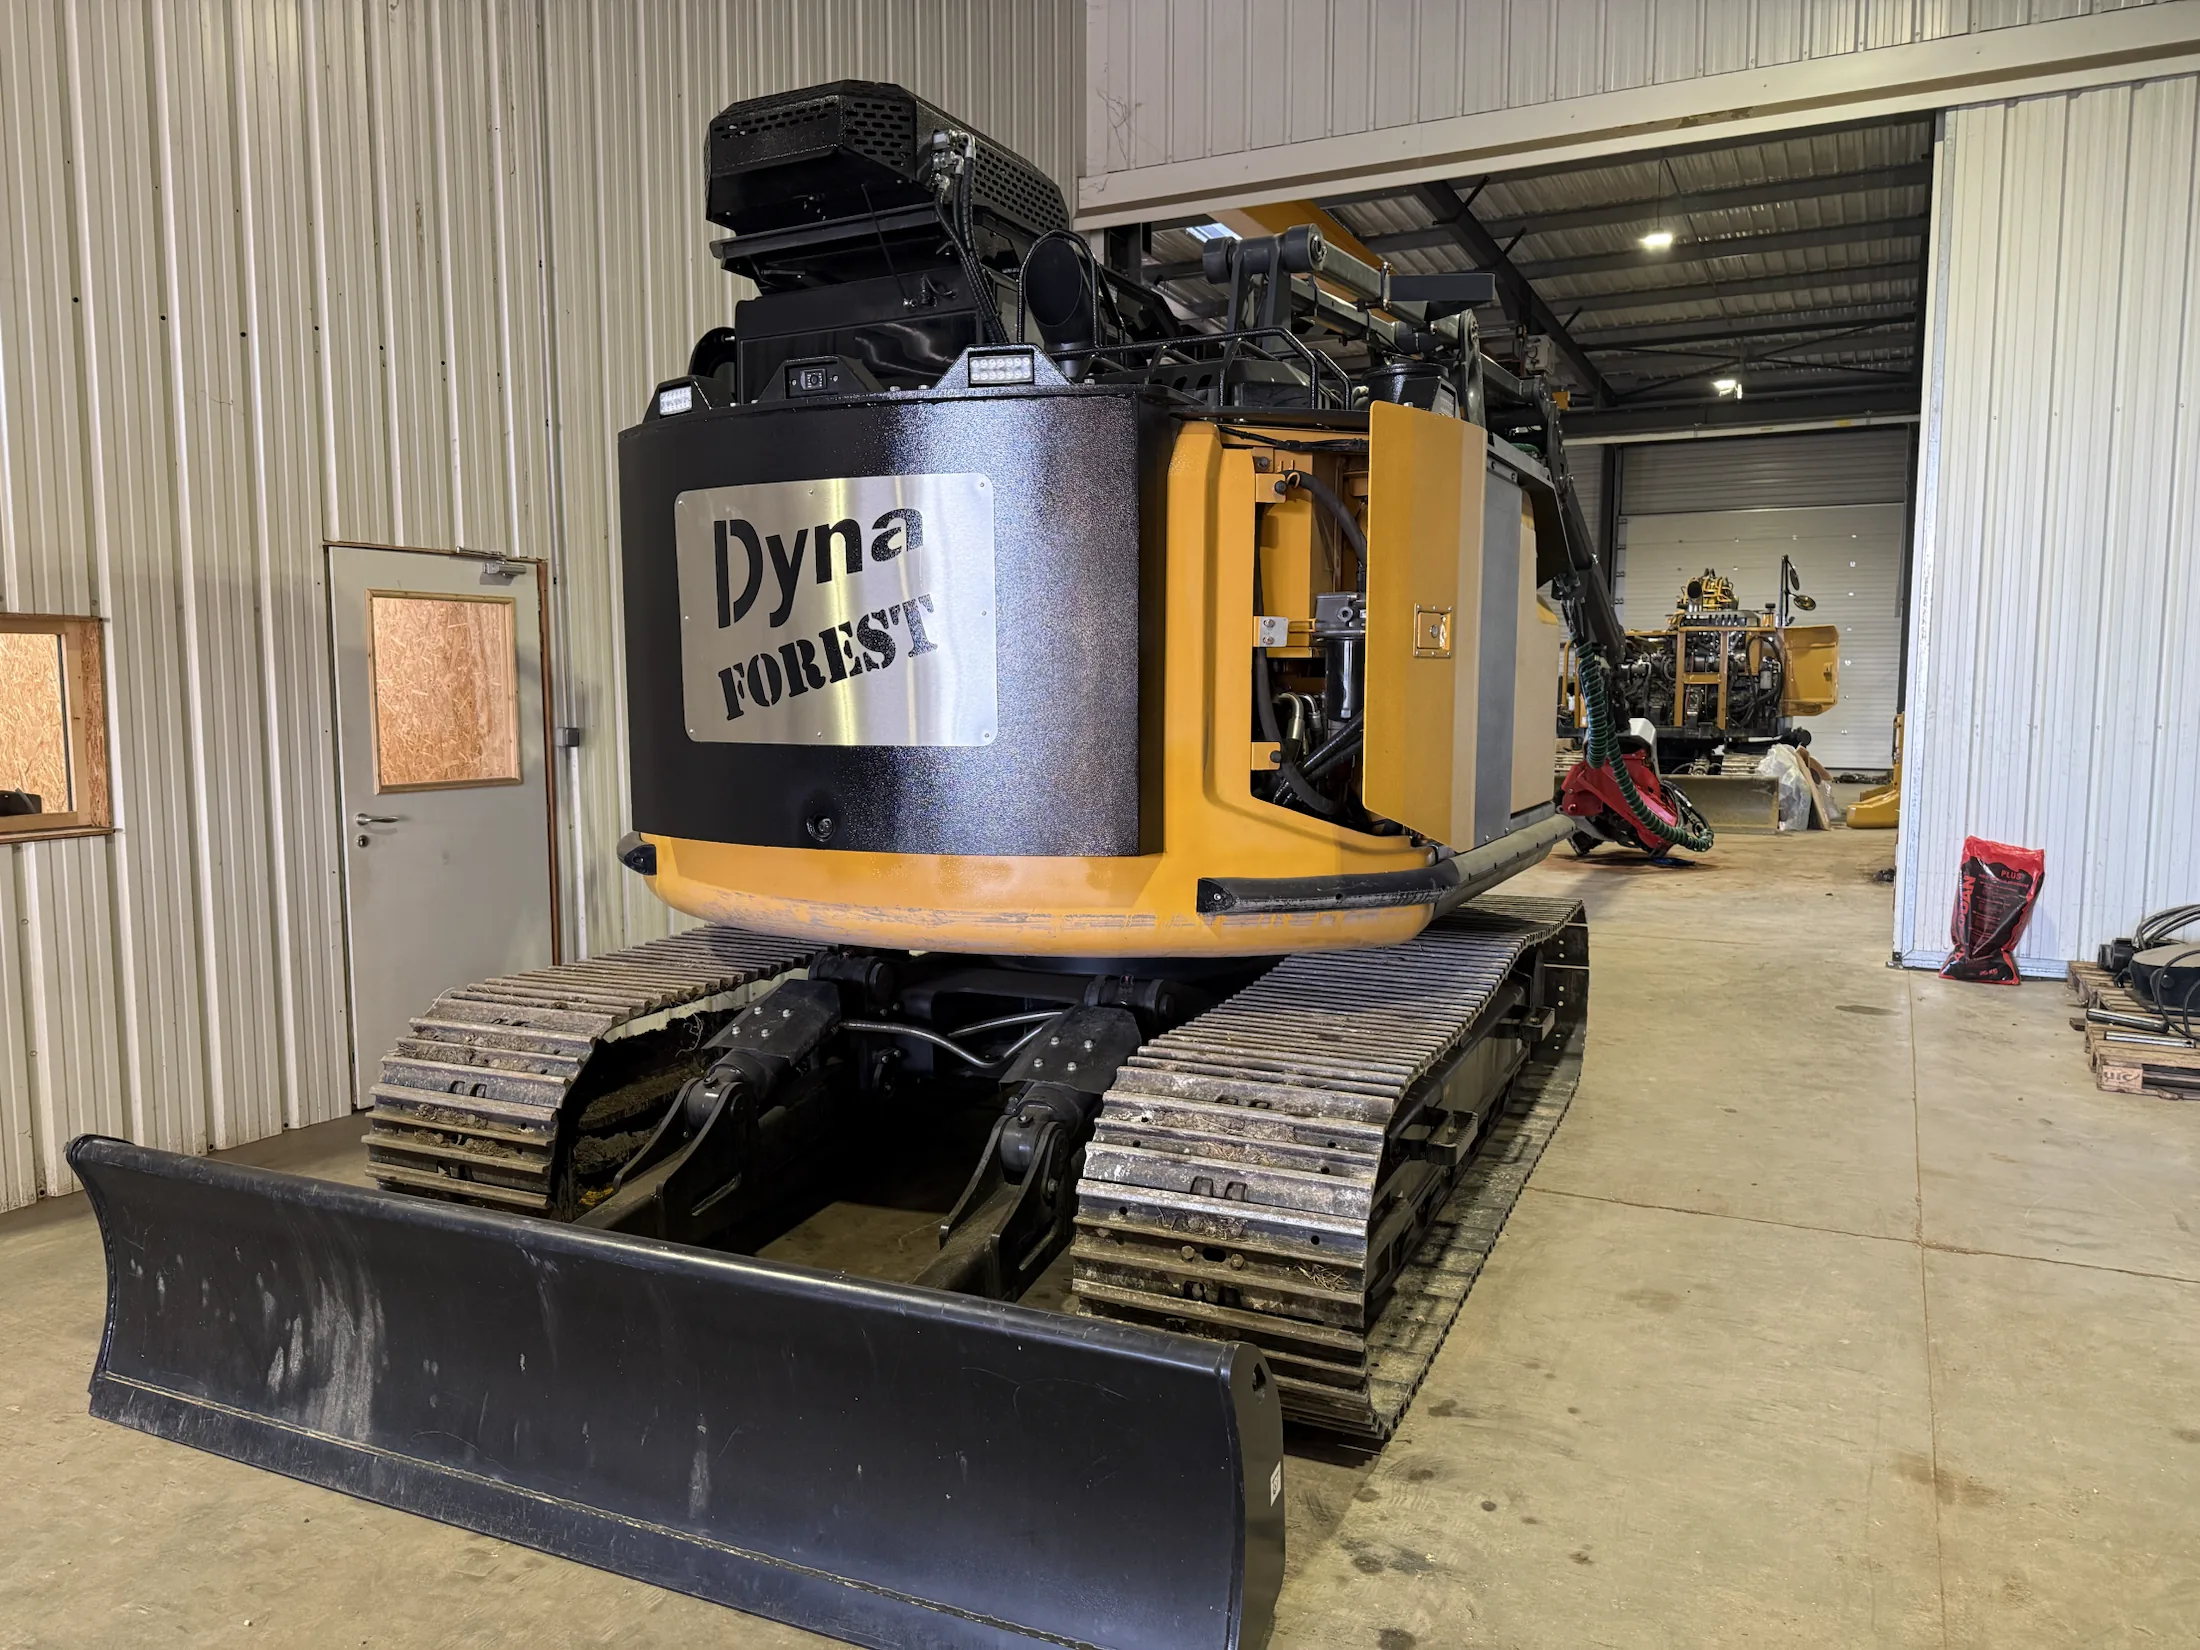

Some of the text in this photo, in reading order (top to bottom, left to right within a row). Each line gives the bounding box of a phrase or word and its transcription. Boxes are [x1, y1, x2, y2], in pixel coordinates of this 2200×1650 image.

[714, 508, 924, 628] Dyna
[718, 594, 938, 721] FOREST
[2000, 869, 2022, 880] PLUS
